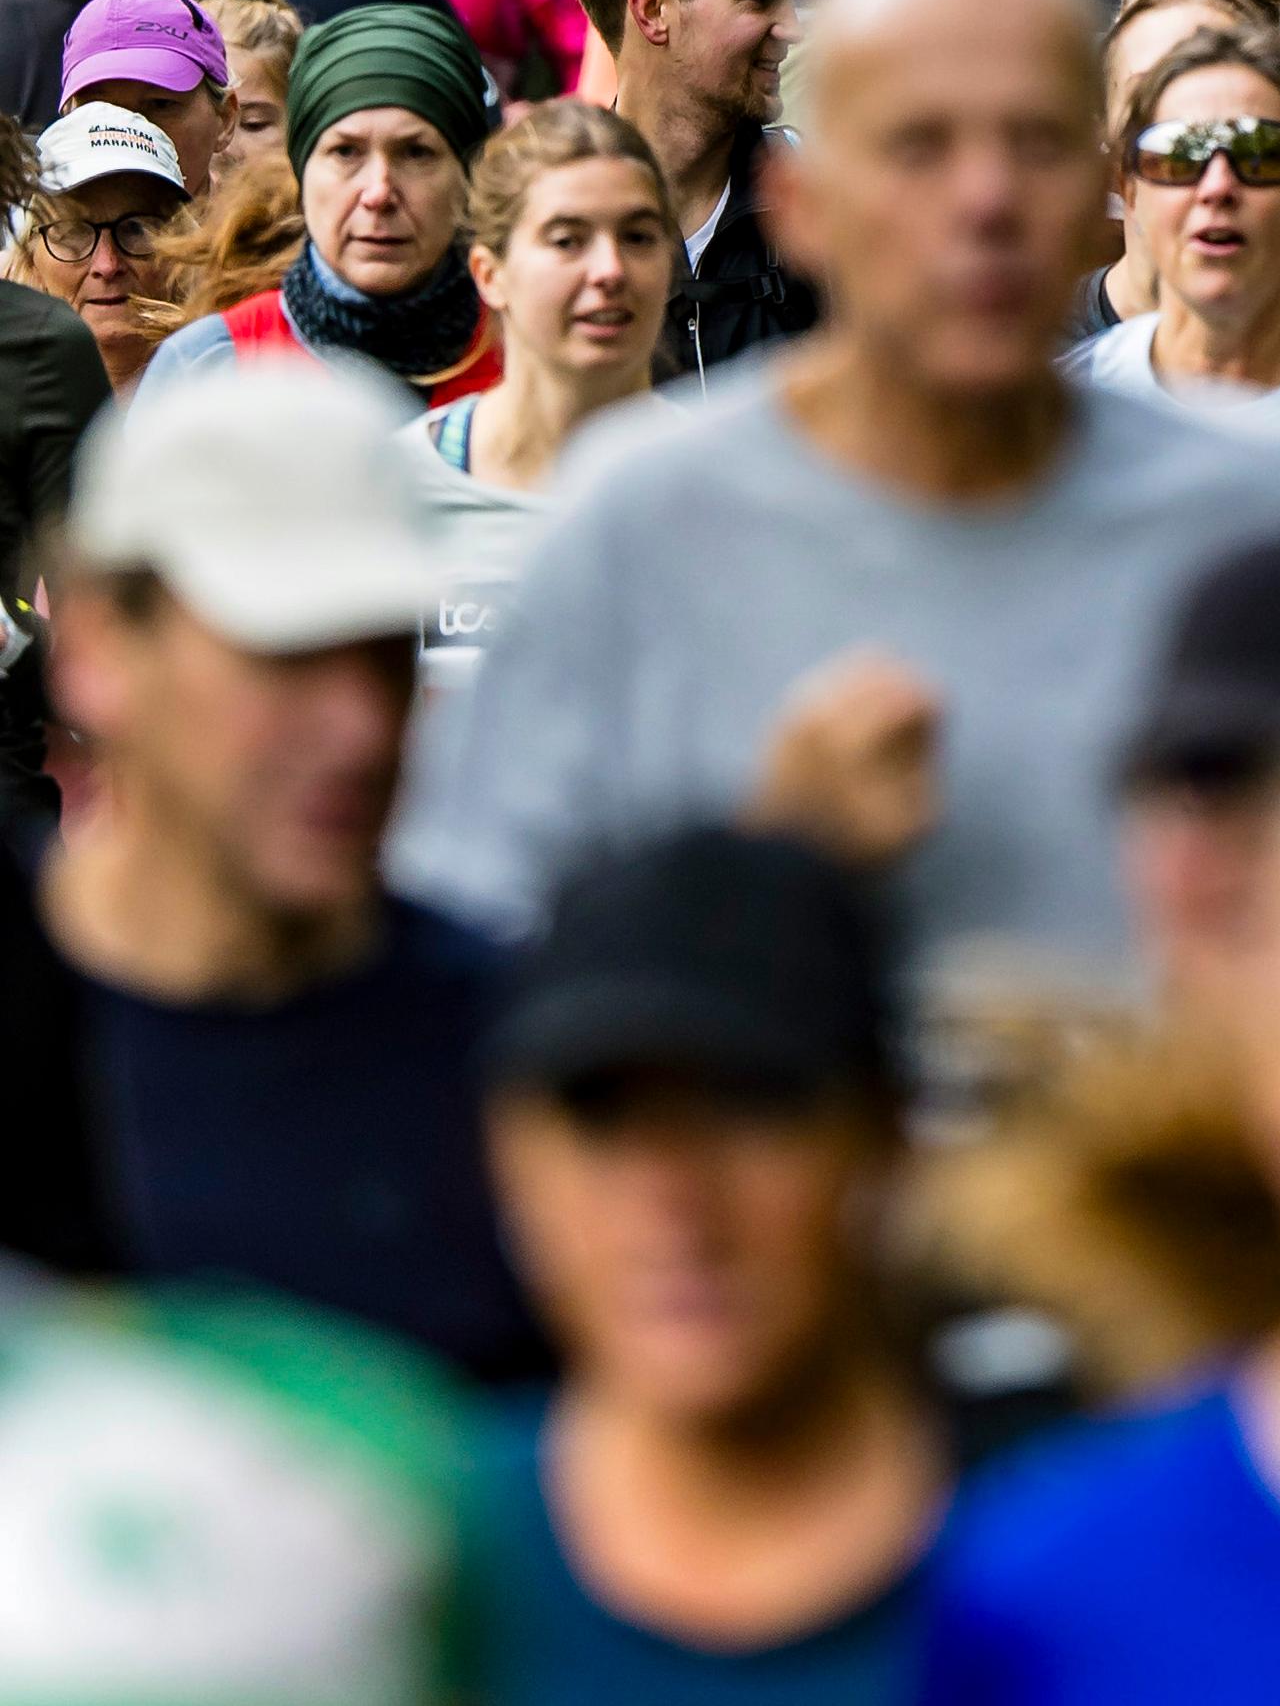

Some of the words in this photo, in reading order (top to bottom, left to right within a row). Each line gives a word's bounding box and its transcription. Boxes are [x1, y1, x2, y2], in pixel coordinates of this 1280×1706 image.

[136, 21, 188, 40] 2XU
[127, 127, 153, 142] TEAM
[91, 139, 158, 158] MARATHON
